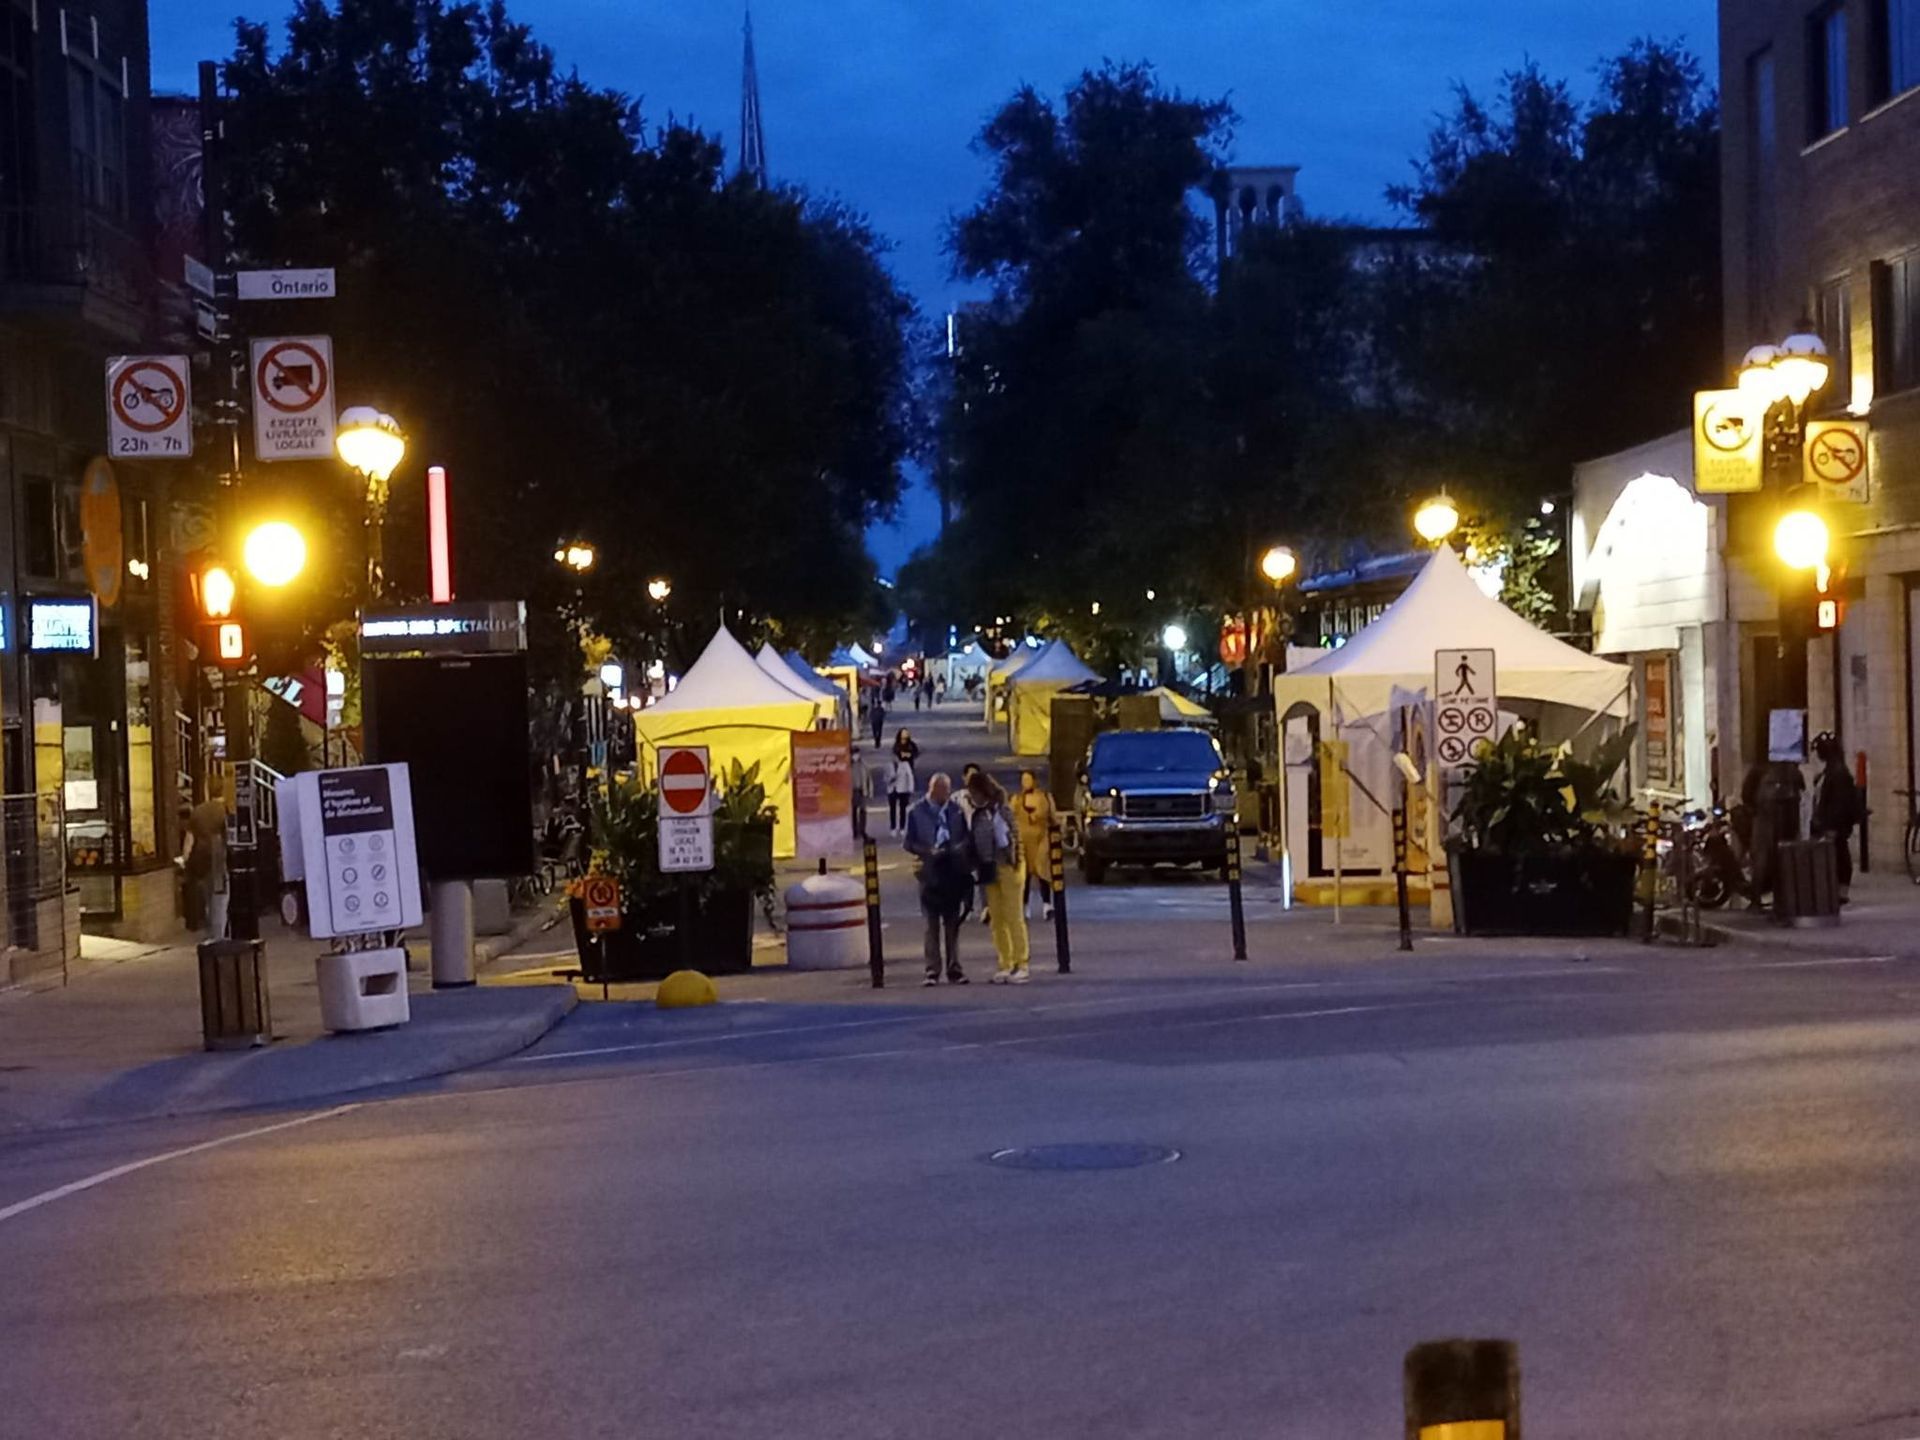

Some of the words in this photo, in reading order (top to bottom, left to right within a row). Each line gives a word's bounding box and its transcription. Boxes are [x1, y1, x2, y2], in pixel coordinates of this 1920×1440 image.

[271, 281, 328, 294] Ontario
[119, 437, 149, 452] 23h
[163, 436, 182, 450] 7h
[437, 619, 506, 635] PECTACLES
